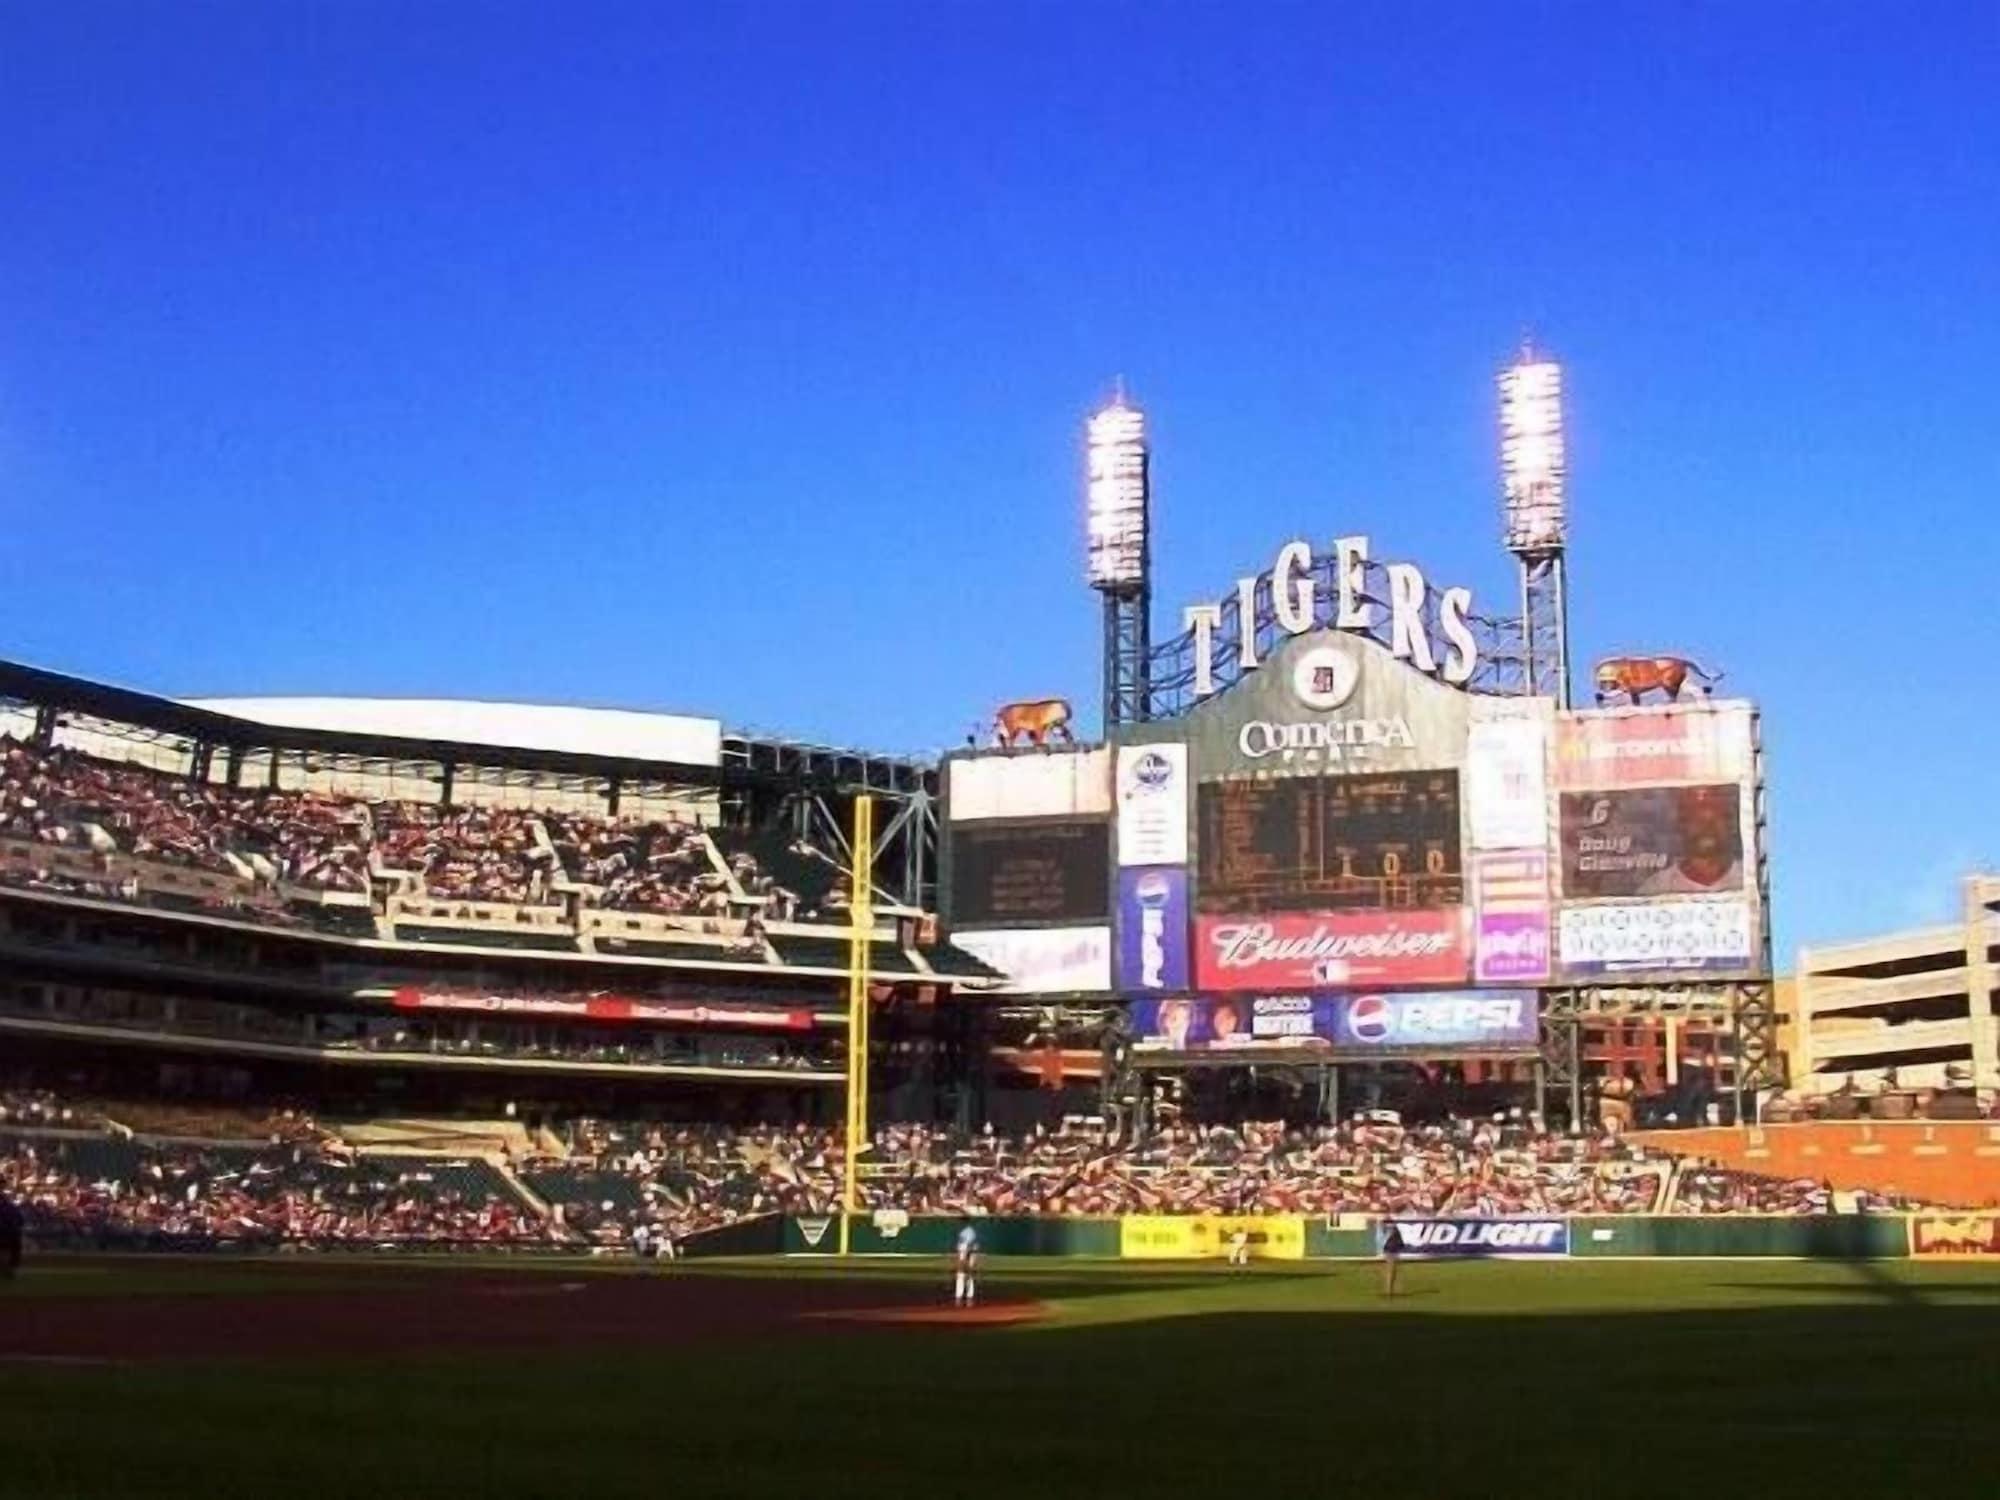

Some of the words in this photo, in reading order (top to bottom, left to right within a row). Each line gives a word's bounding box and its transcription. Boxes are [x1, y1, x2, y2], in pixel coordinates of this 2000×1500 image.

[1184, 535, 1478, 697] TIGERS
[1210, 922, 1453, 969] Budweiser
[1458, 1222, 1562, 1246] LIGHT
